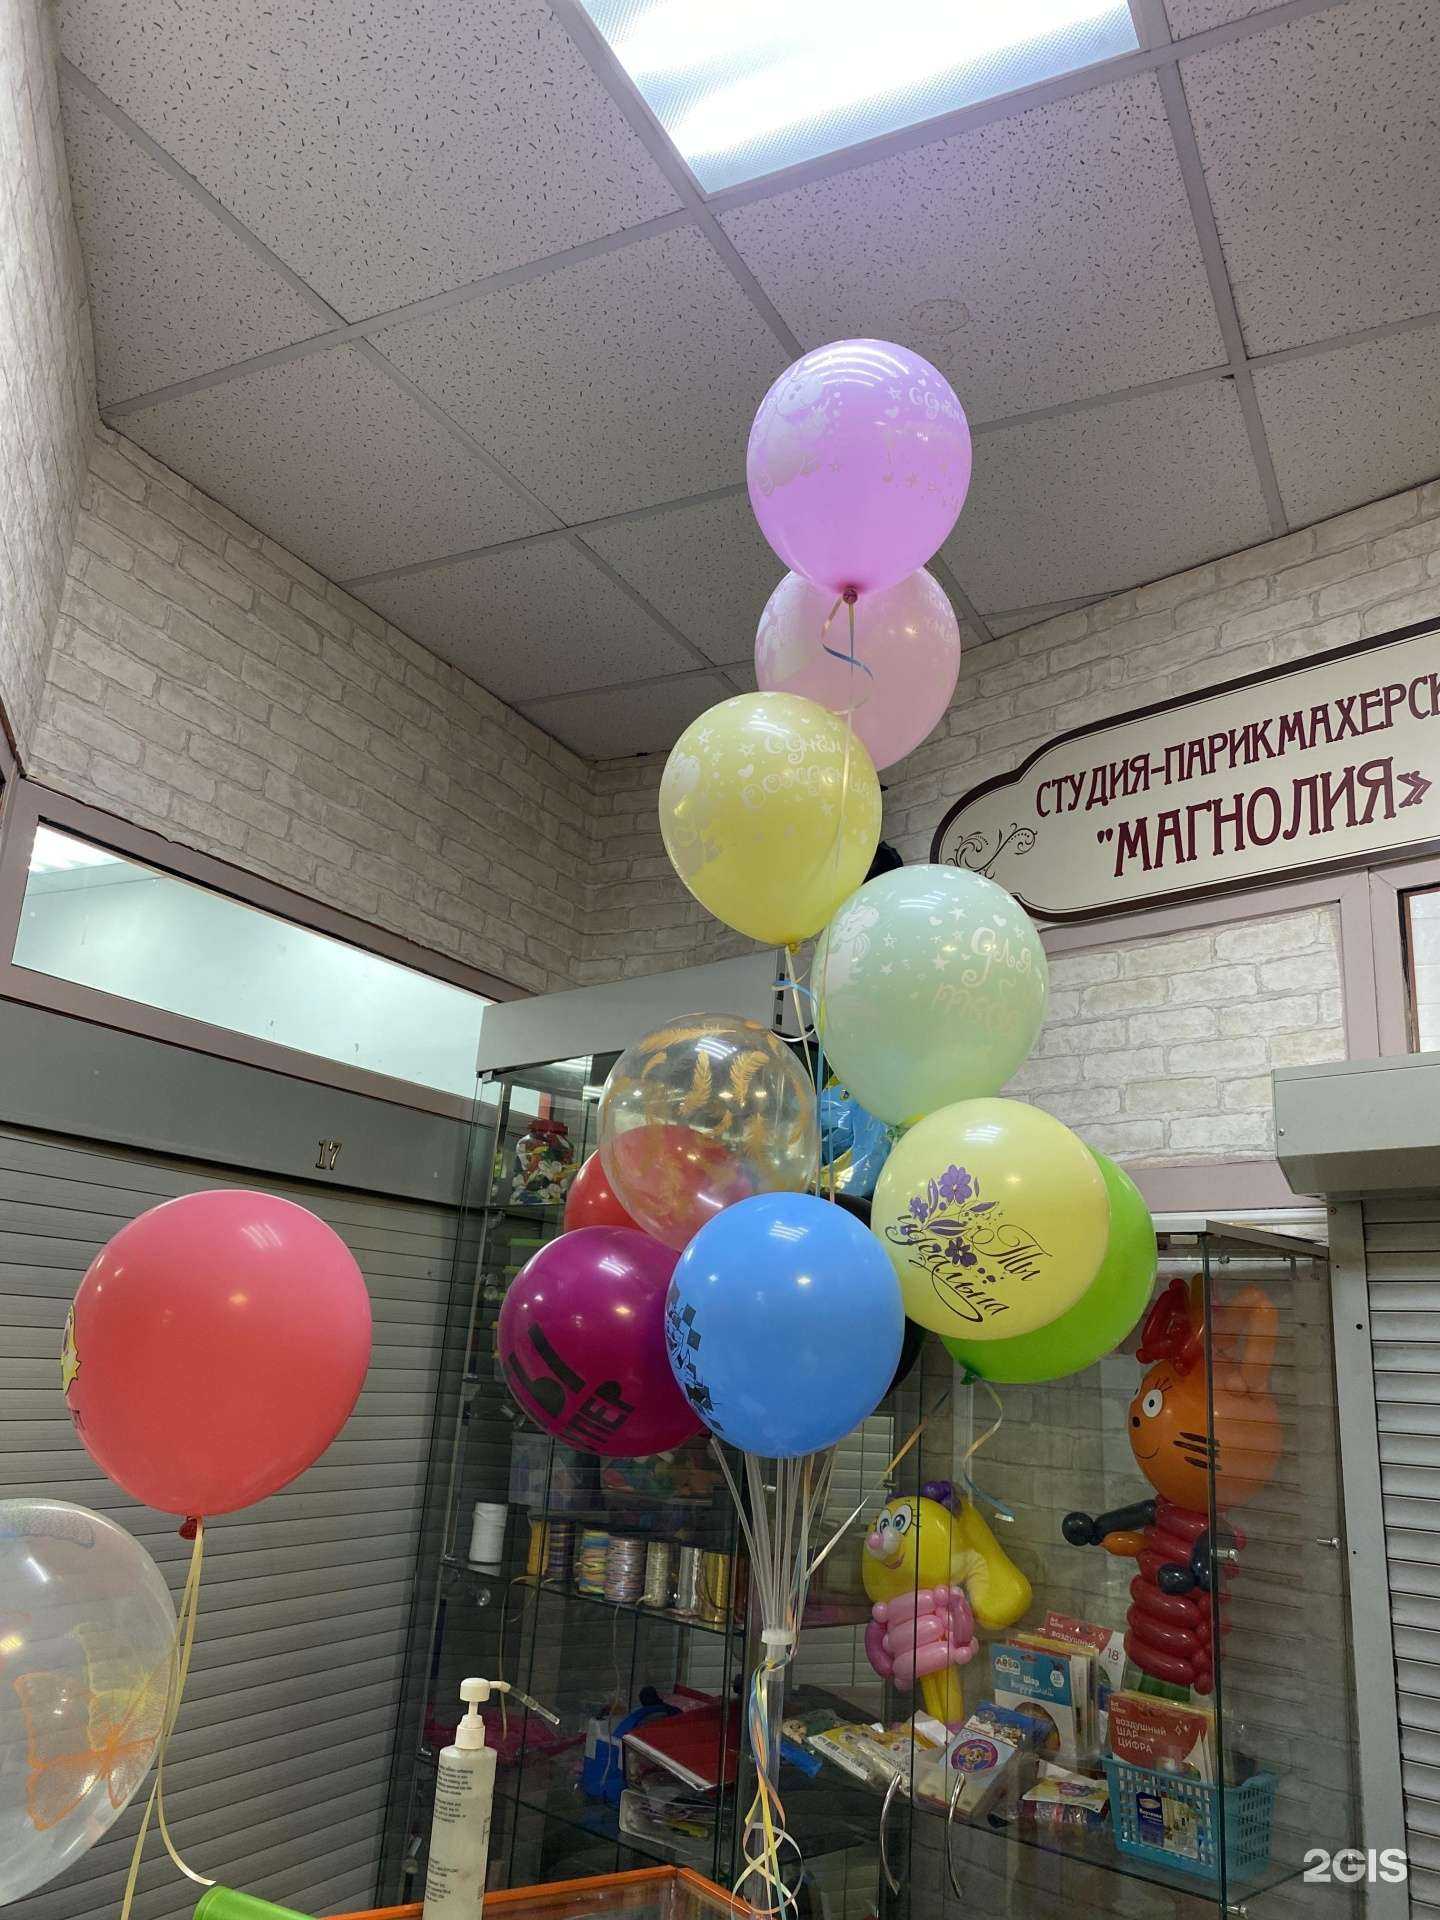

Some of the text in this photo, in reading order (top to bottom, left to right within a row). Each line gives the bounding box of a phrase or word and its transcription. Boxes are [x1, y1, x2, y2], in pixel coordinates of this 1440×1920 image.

[316, 1140, 342, 1170] 17
[1108, 1647, 1120, 1661] 18
[1118, 1737, 1153, 1754] ЦИФРА
